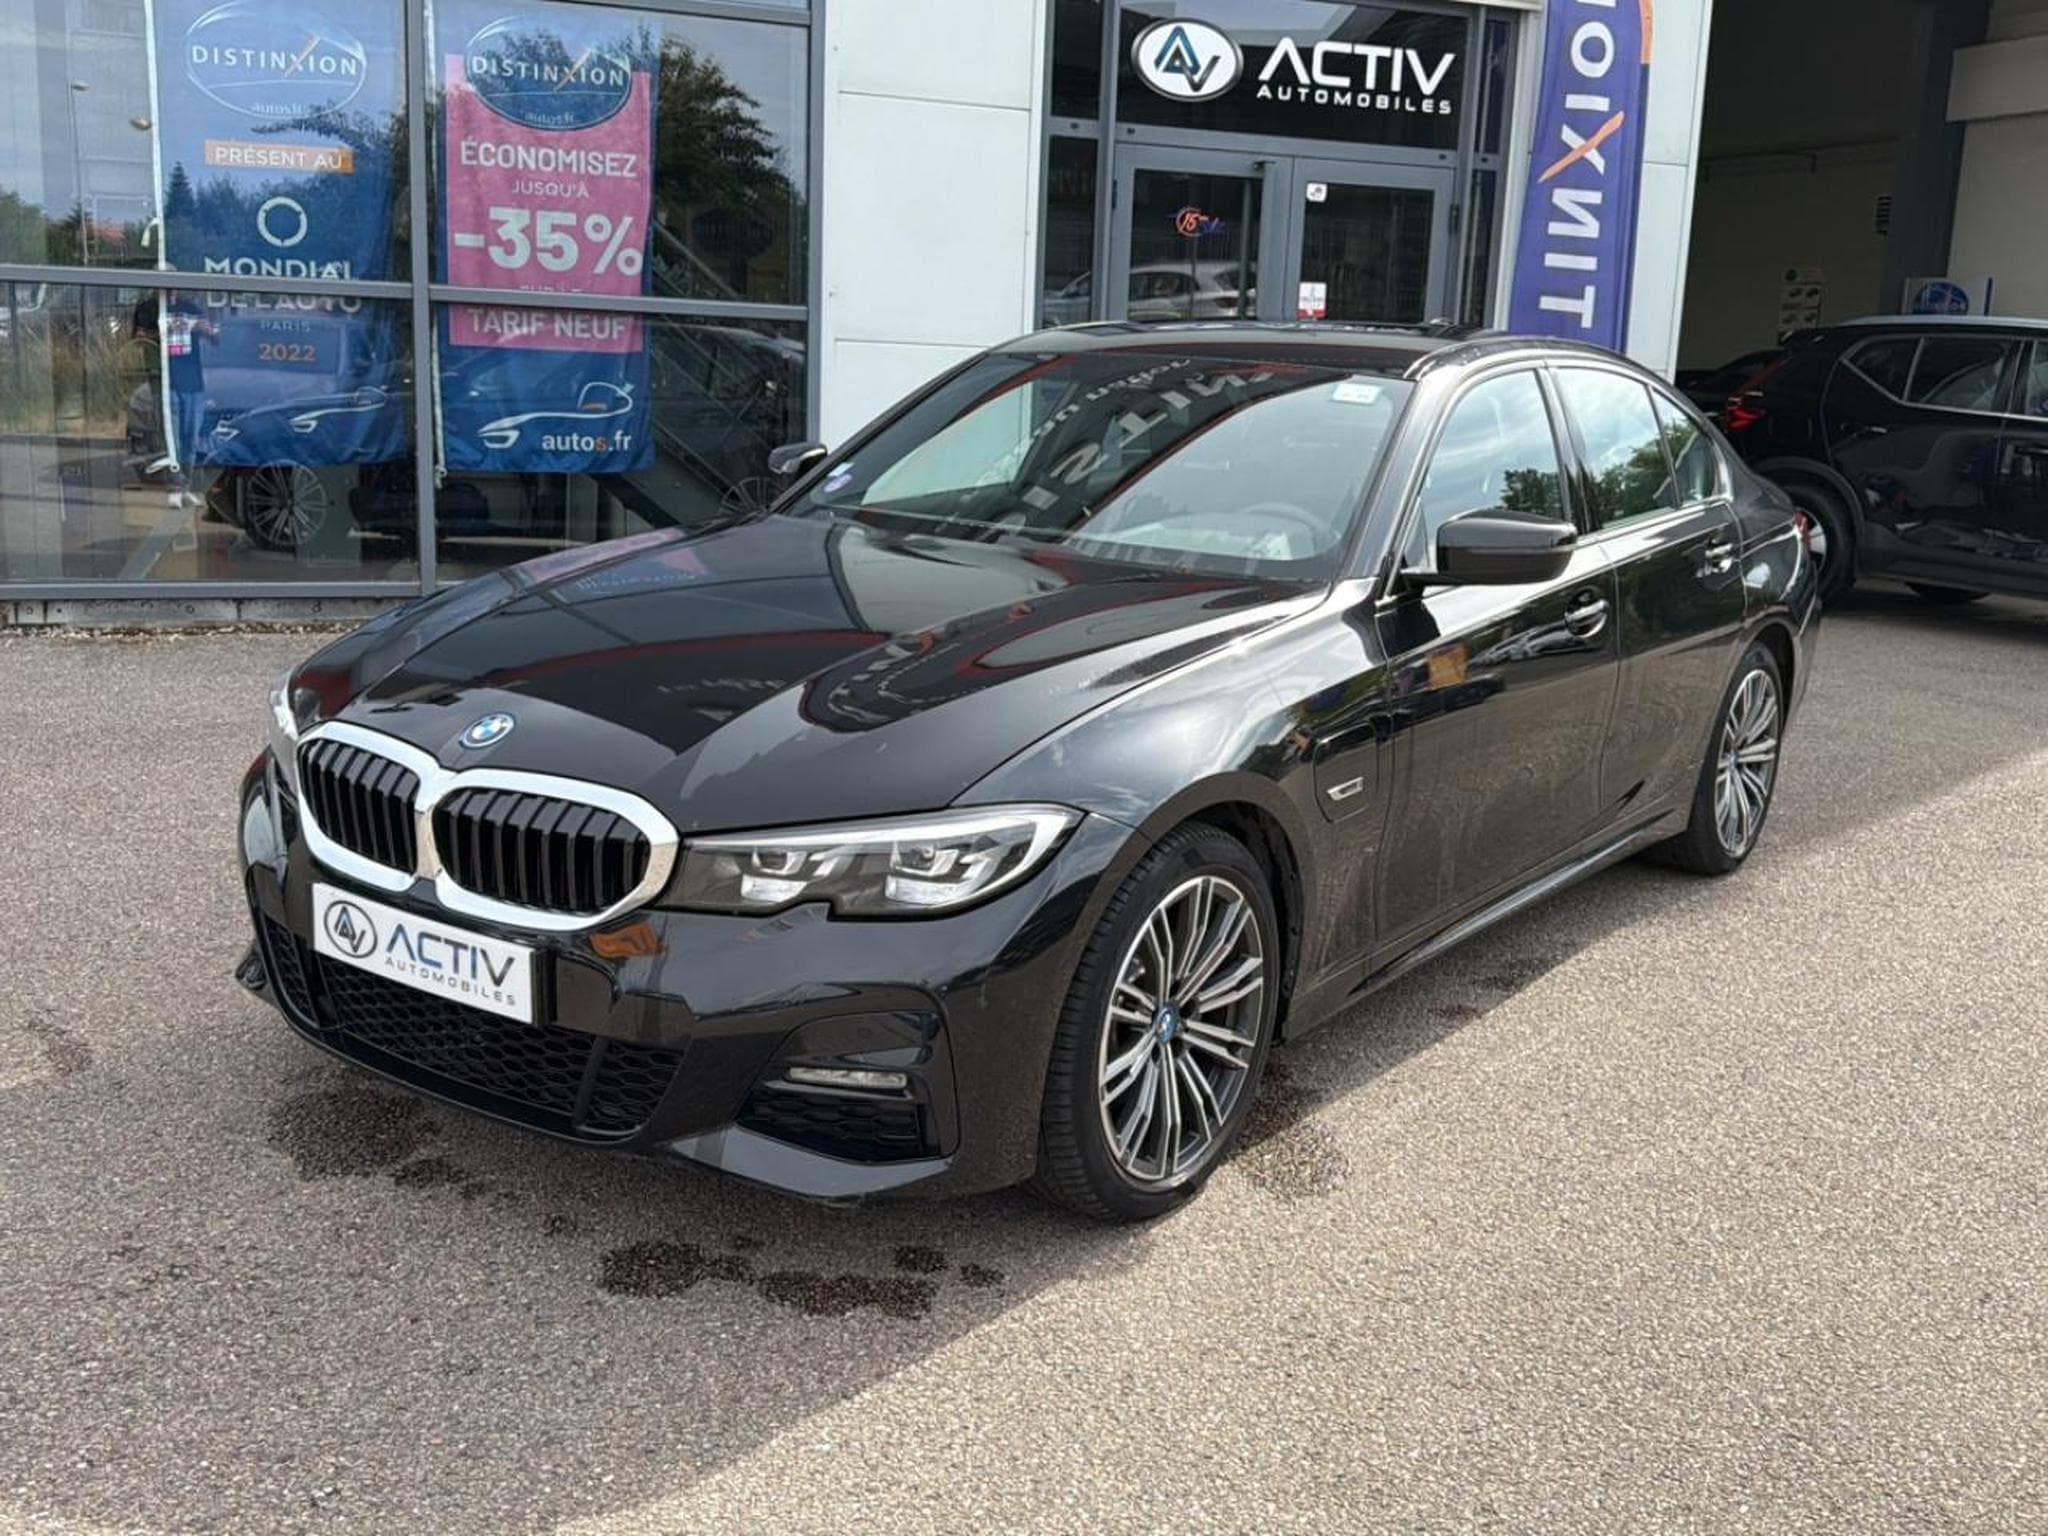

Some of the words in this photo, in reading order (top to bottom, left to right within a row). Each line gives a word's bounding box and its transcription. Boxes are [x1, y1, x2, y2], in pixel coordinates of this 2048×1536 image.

[192, 34, 357, 77] DISTINXION
[472, 49, 624, 91] DISTINXION
[1258, 37, 1456, 96] ACTIV
[1256, 84, 1452, 115] AUTOMOBILES
[215, 146, 305, 168] PRÉSENT
[313, 152, 343, 169] AU
[460, 135, 638, 178] ÉCONOMISEZ
[261, 320, 311, 333] PARIS
[467, 308, 545, 336] TARIF
[258, 343, 316, 362] 2022
[541, 429, 633, 453] autos.fr
[386, 923, 516, 987] ACTIV
[385, 956, 516, 1006] AUTOMOBILES
